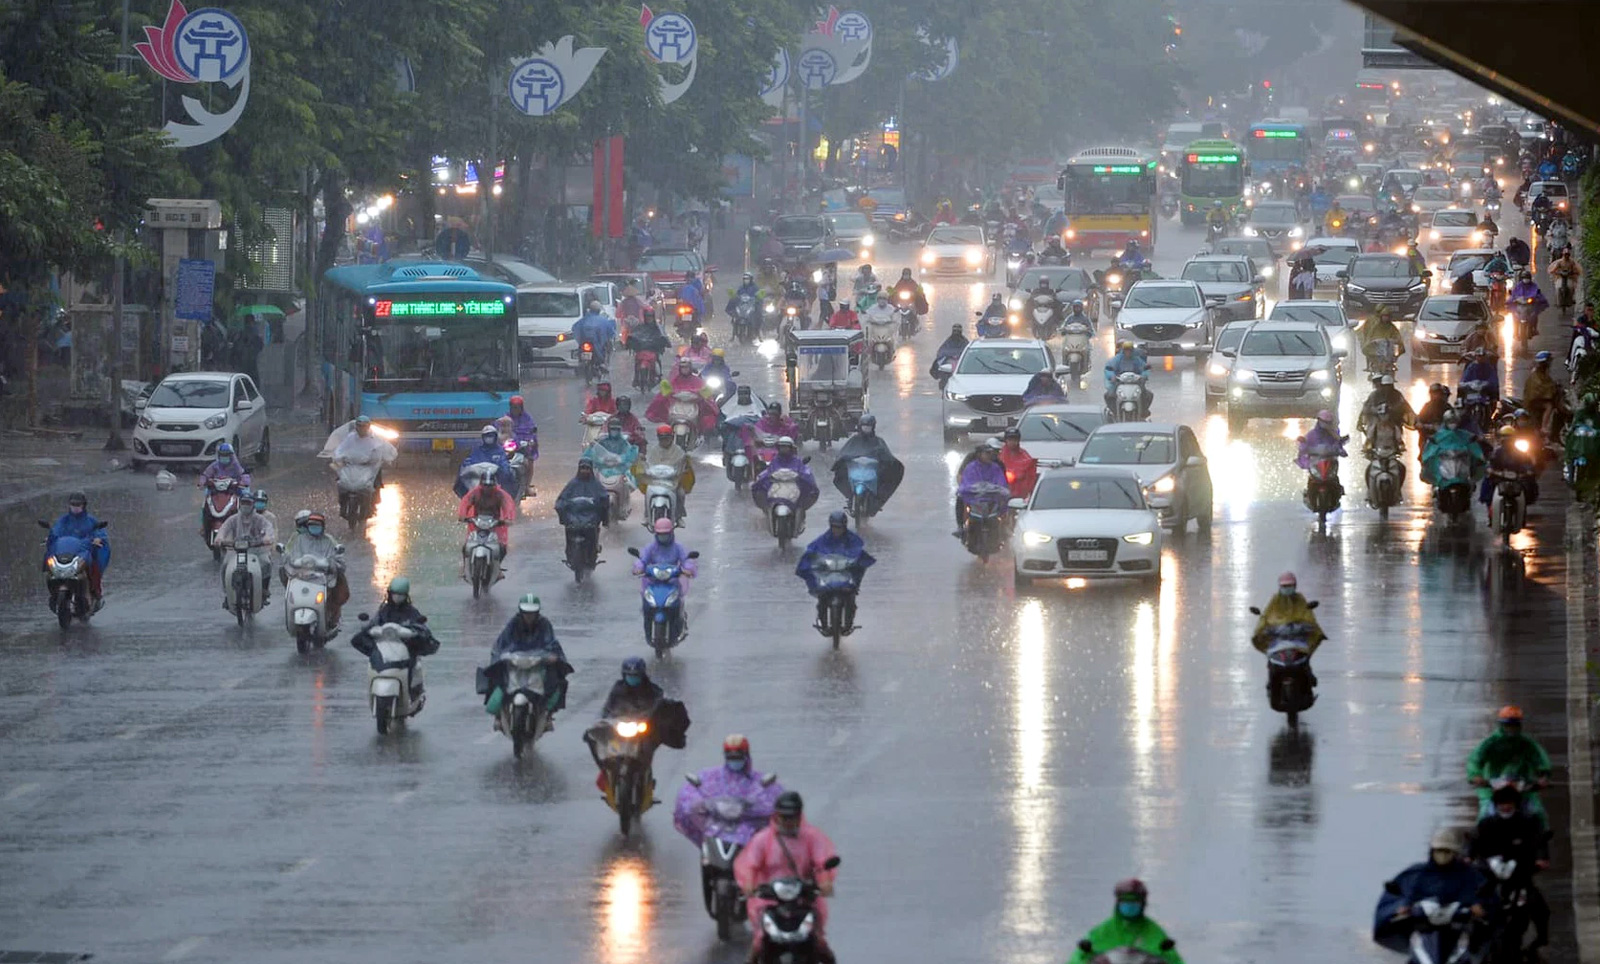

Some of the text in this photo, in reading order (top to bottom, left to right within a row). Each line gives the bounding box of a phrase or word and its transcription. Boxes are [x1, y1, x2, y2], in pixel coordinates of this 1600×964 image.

[375, 301, 391, 317] 27
[391, 303, 409, 314] NAM
[435, 303, 456, 314] LONG
